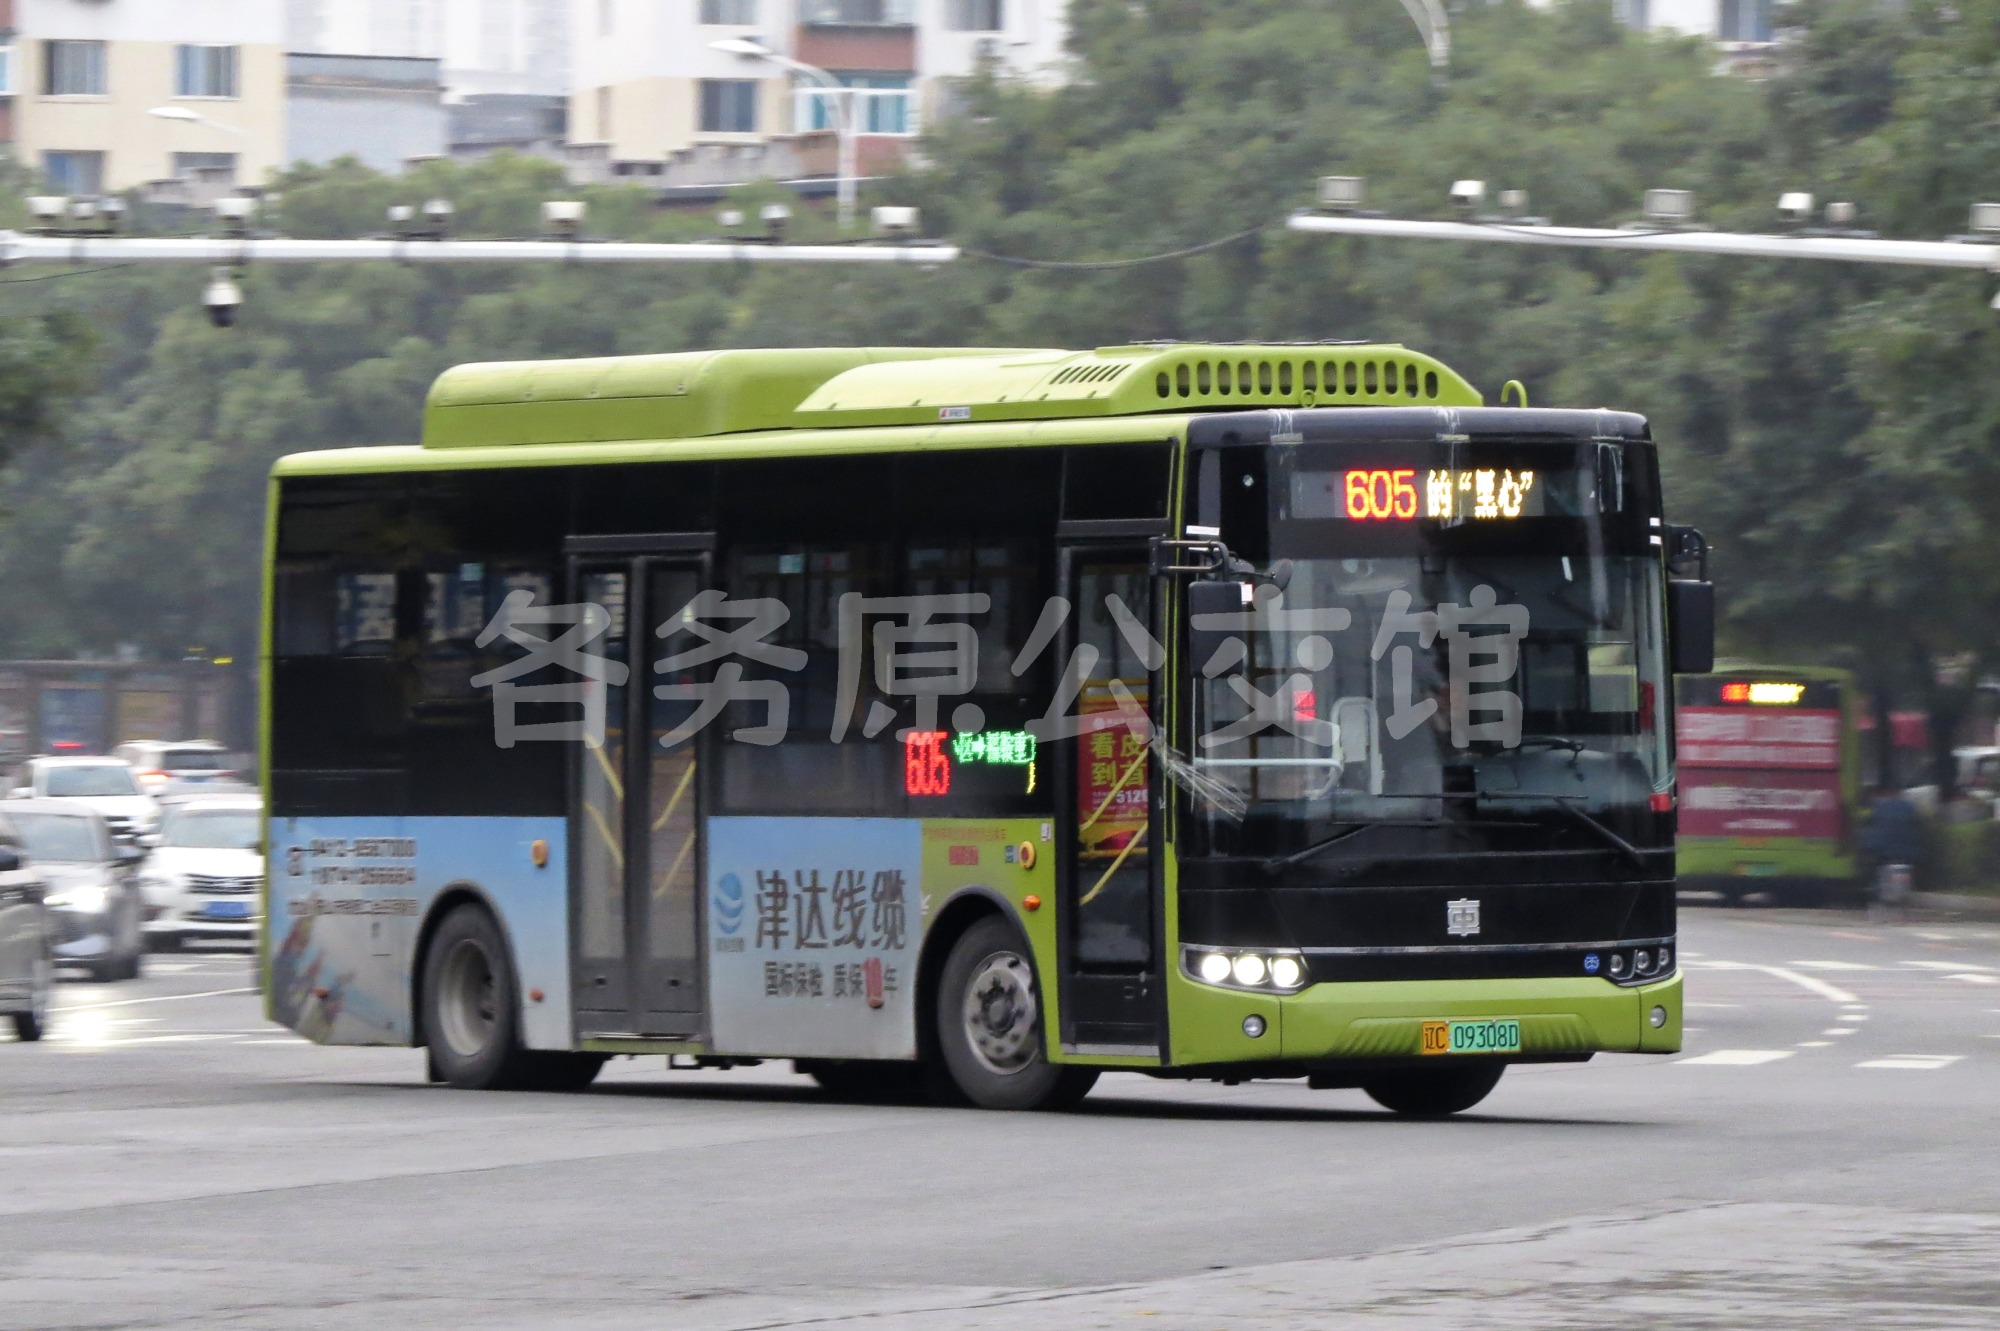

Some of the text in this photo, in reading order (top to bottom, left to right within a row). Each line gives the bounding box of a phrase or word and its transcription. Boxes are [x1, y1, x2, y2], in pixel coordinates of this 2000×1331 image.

[1345, 469, 1418, 520] 605
[755, 869, 905, 949] 津达线缆
[1454, 1024, 1518, 1049] 09308D
